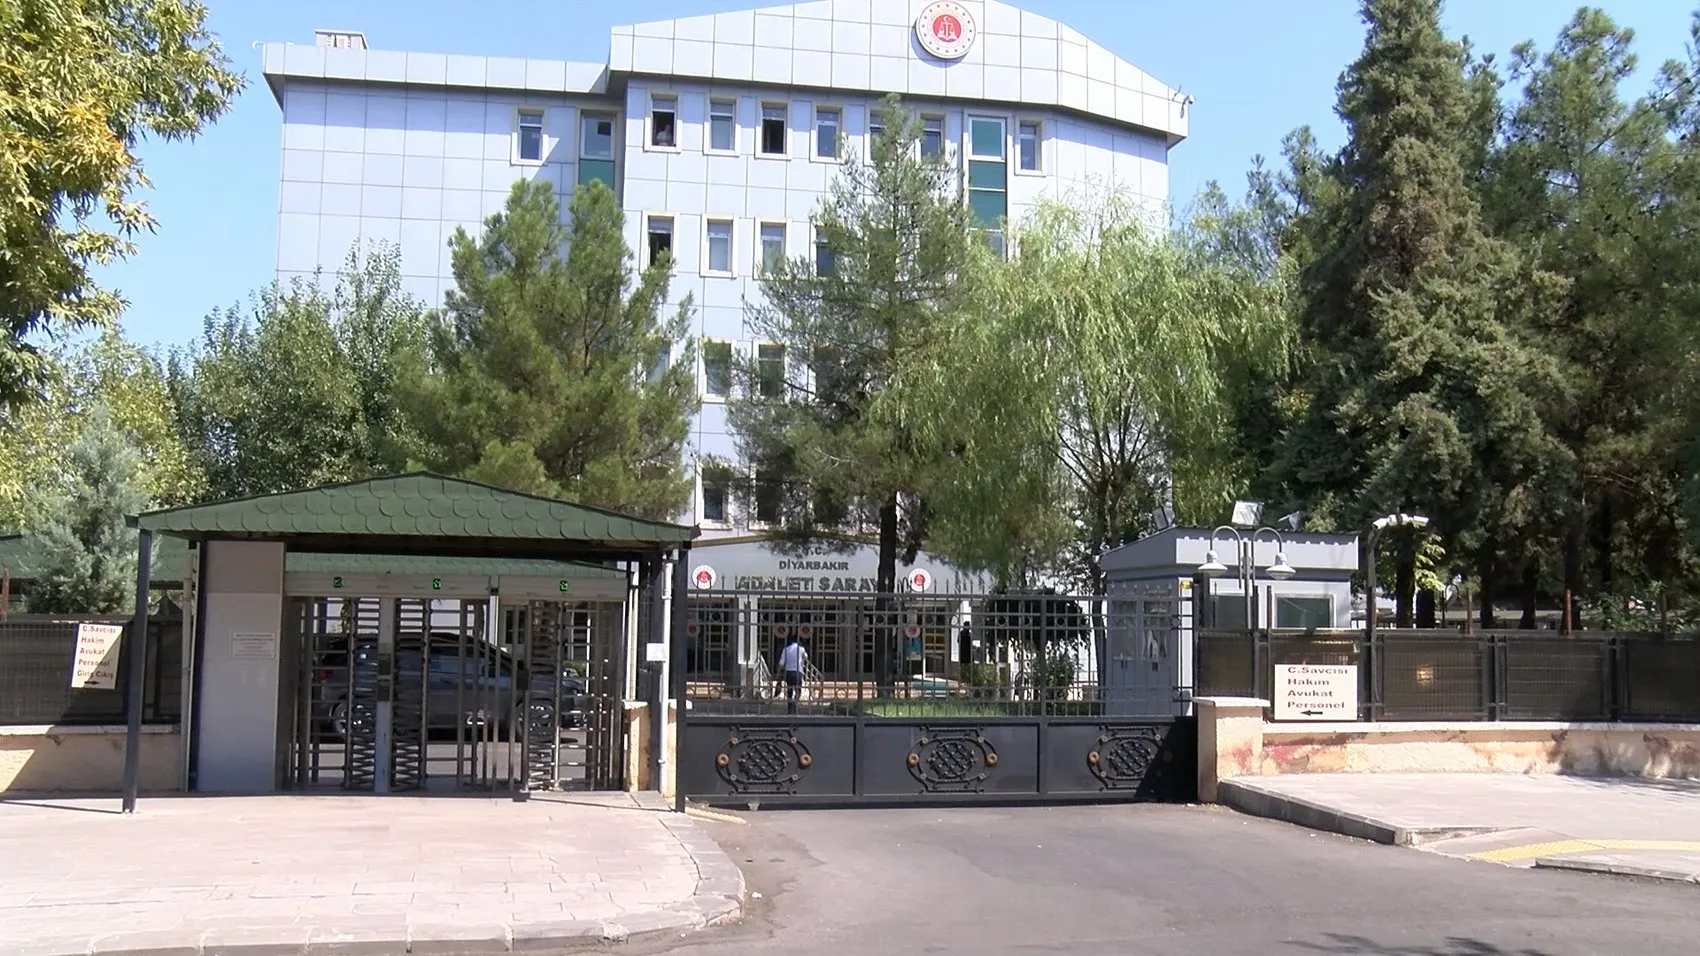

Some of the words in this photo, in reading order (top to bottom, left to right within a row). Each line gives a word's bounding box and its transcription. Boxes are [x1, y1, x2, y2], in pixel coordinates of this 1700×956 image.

[779, 558, 849, 571] DİYARBAKIR
[736, 576, 814, 592] ADALET
[819, 576, 879, 592] SARAY
[79, 647, 105, 655] Avukat
[78, 658, 110, 666] Personel
[1287, 689, 1333, 697] Avukat
[1287, 701, 1345, 709] Personel
